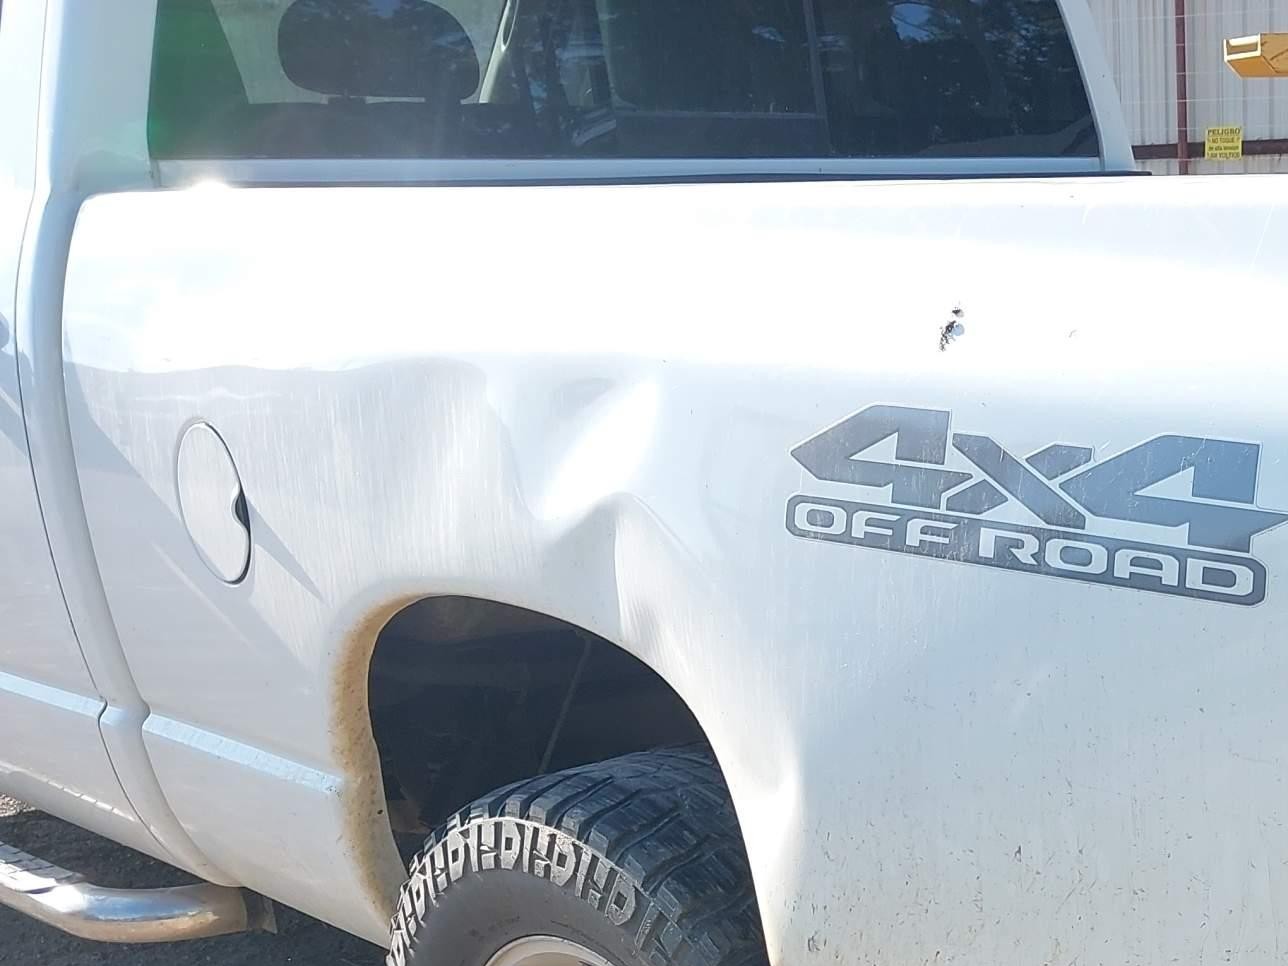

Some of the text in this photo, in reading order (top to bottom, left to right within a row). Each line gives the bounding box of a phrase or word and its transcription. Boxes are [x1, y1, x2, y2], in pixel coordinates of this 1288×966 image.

[1207, 128, 1241, 136] PELIGRO
[793, 501, 1255, 596] OFF ROAD
